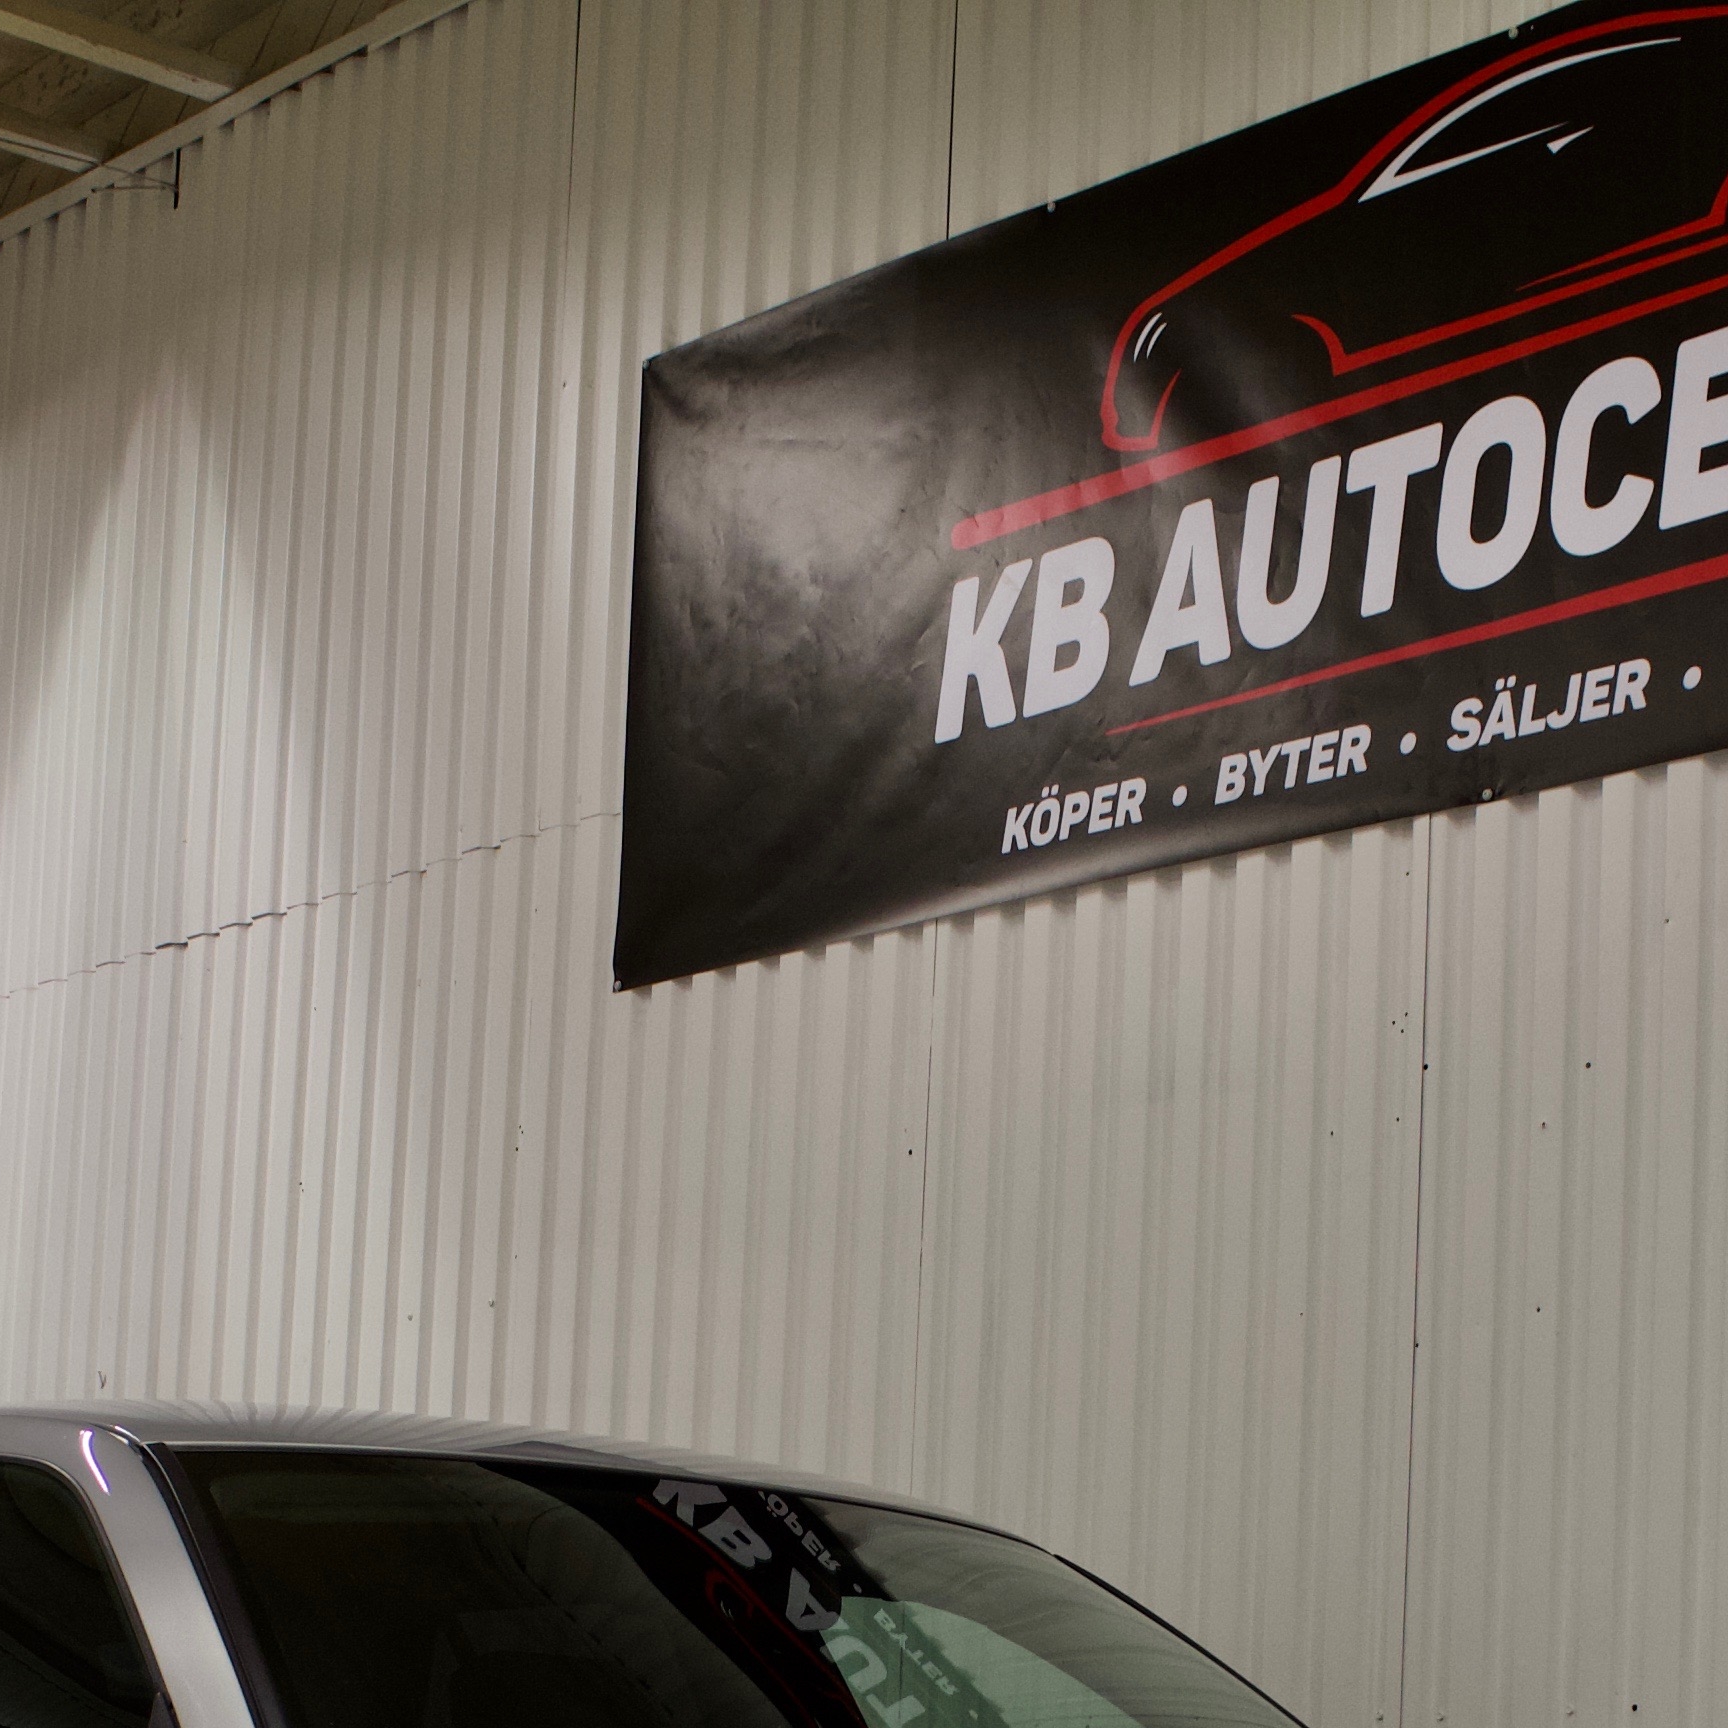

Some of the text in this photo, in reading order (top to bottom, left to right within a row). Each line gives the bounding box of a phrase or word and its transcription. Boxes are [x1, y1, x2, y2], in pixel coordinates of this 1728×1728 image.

[933, 538, 1116, 745] KB
[1000, 776, 1148, 855] KÖPER
[1214, 723, 1372, 806] BYTER
[1446, 658, 1652, 752] SÄLJER
